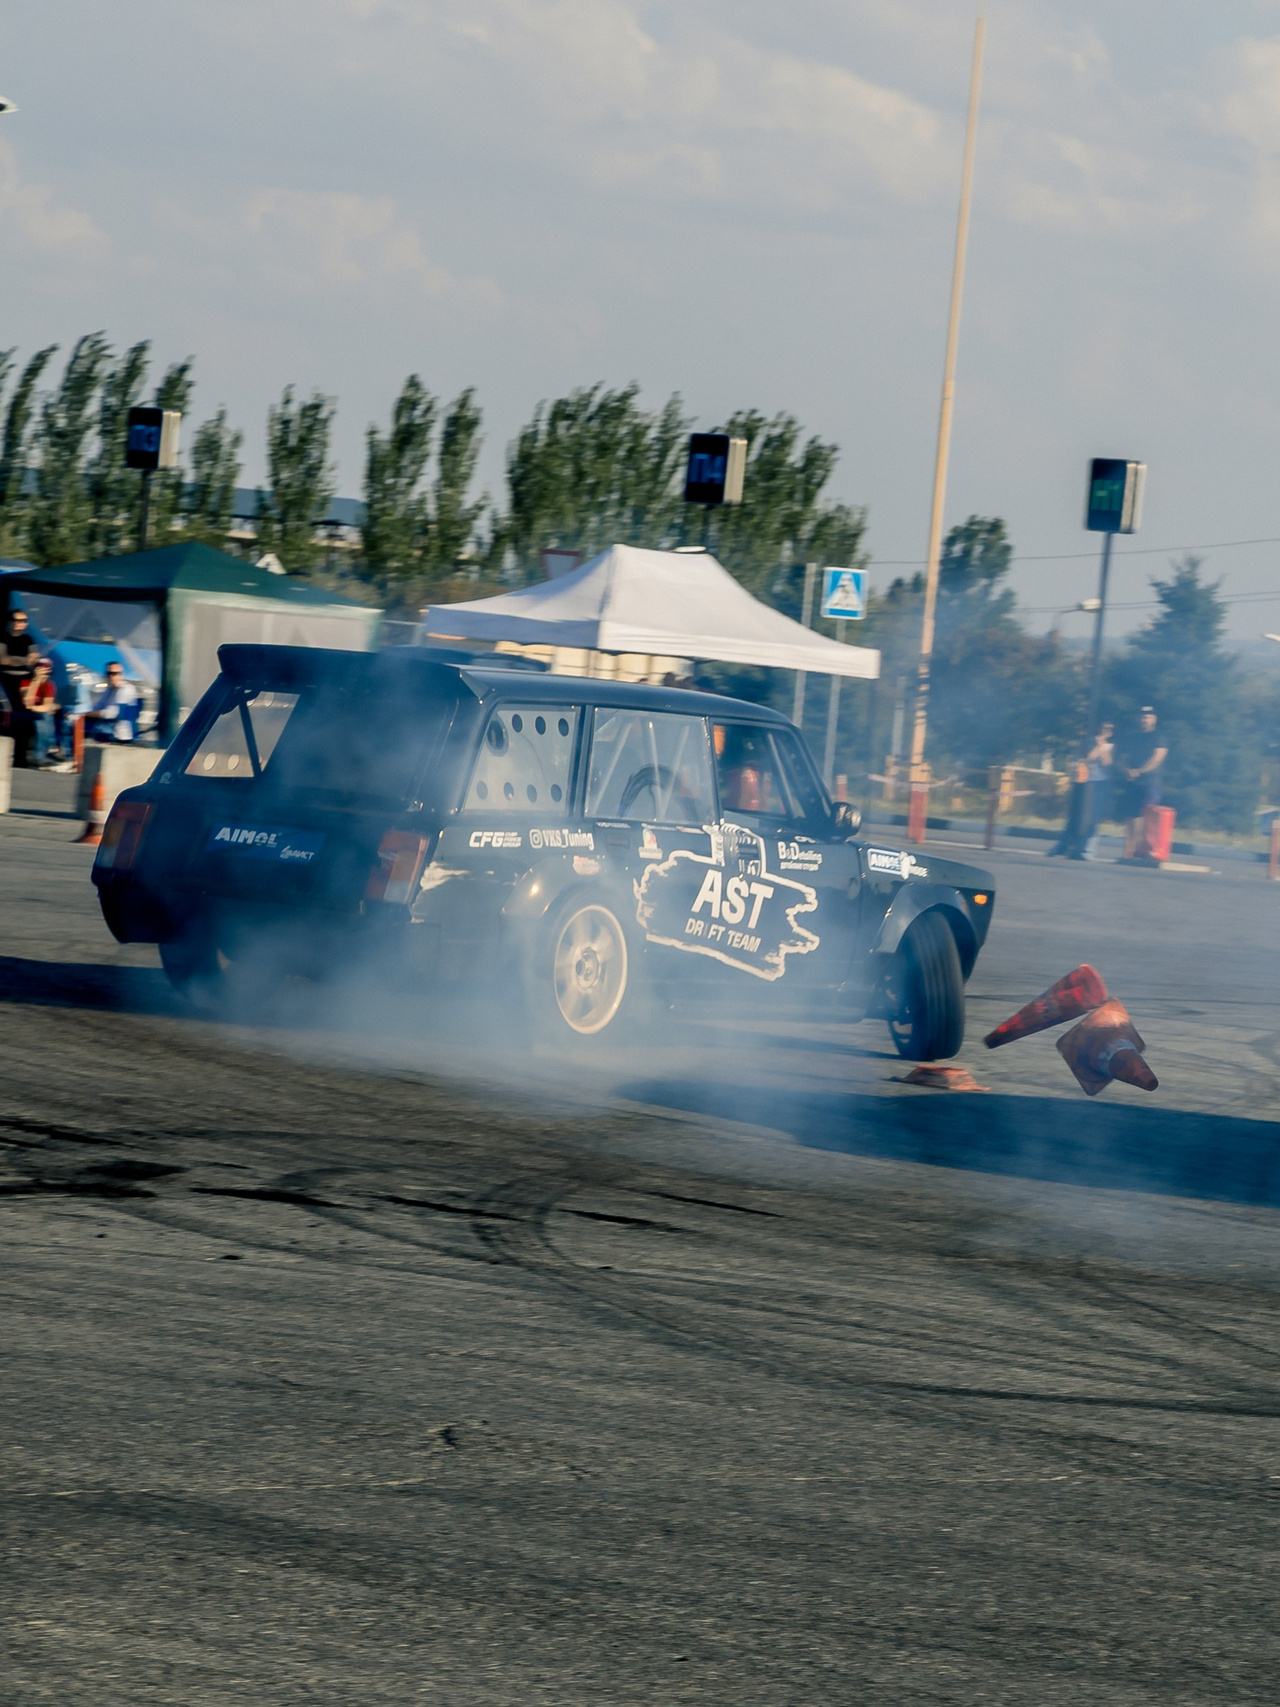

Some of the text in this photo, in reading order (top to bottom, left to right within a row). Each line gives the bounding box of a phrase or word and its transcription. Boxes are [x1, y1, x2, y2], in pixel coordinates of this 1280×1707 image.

[214, 827, 279, 848] AIMOL
[469, 831, 505, 848] CFG
[691, 869, 774, 929] AST
[727, 930, 762, 953] TEAM
